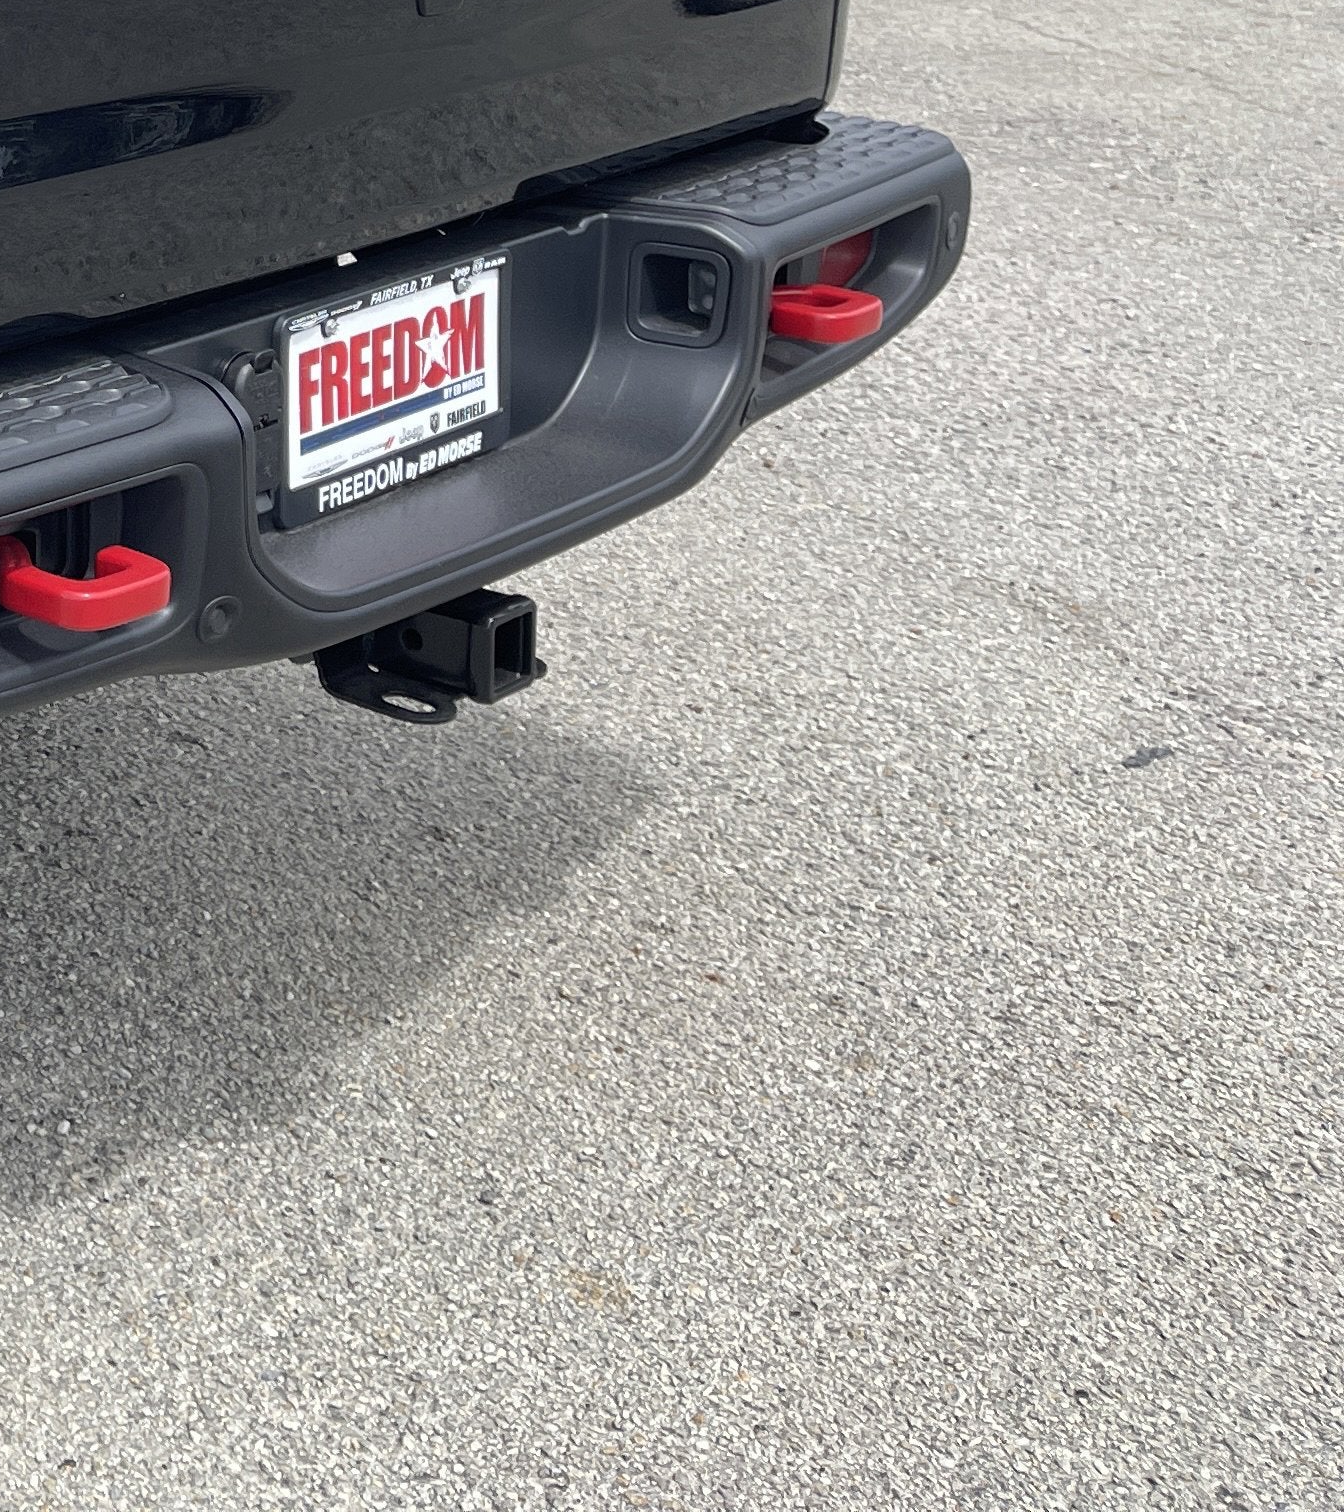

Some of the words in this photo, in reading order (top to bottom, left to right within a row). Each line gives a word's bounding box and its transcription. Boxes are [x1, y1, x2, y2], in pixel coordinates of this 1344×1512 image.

[370, 279, 418, 306] FAIRFIELD,
[421, 274, 434, 290] TX
[299, 292, 485, 435] FREEDOM
[447, 400, 486, 427] FAIRFIELD
[319, 456, 404, 513] FREEDOM
[419, 450, 437, 475] ED
[437, 431, 483, 467] MORSE
